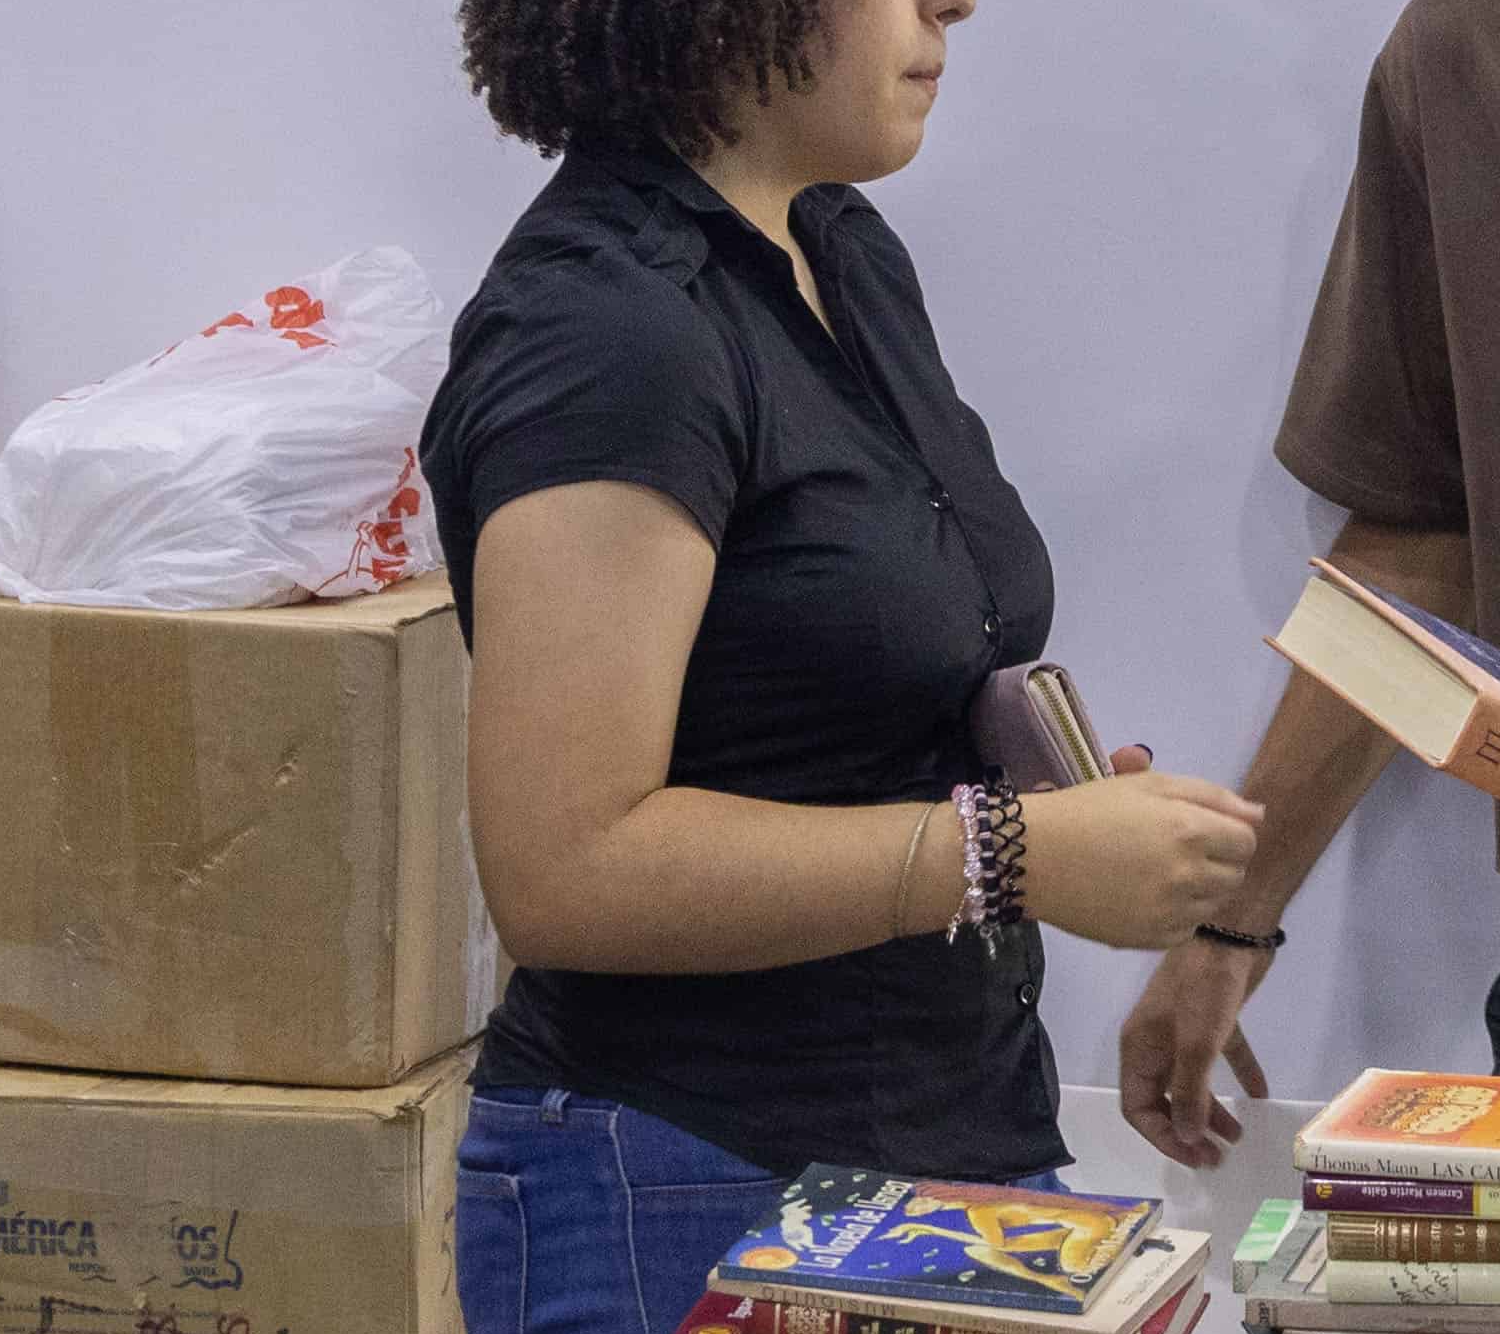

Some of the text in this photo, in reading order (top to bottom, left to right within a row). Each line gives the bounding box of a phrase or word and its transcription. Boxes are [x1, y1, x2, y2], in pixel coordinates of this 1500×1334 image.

[1311, 1151, 1420, 1177] Thomas Mann
[1431, 1161, 1467, 1179] LAS
[1361, 1185, 1390, 1198] Gaite
[1426, 1186, 1464, 1200] Carmen
